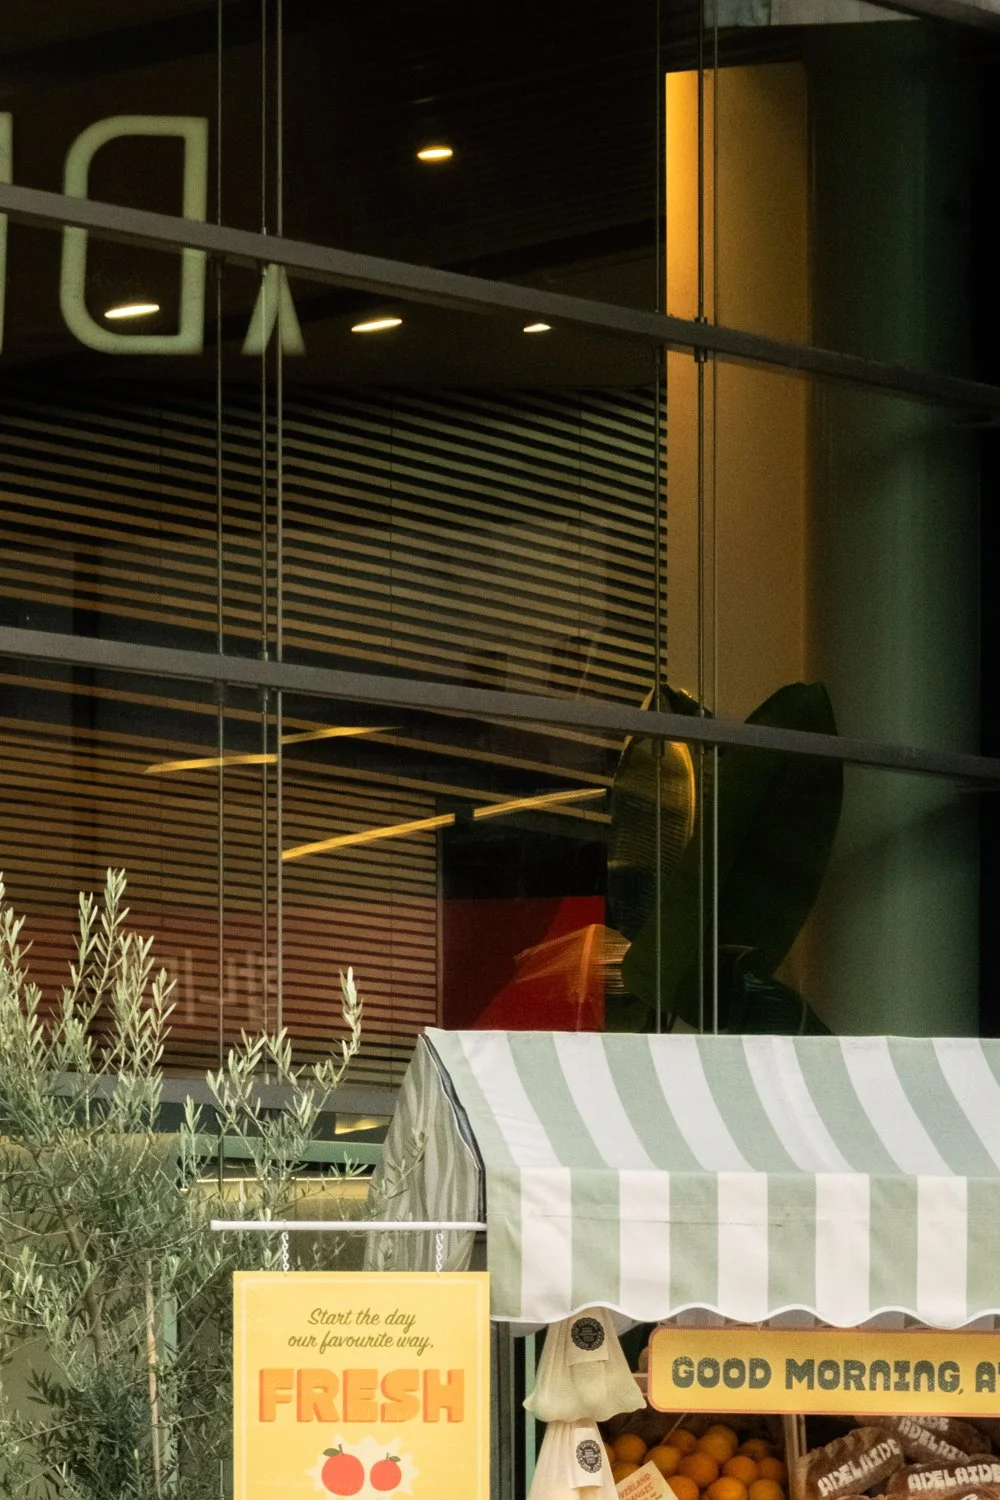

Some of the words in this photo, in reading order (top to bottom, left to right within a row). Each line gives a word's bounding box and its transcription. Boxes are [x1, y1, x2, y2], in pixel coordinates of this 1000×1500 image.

[307, 1308, 352, 1326] Start
[355, 1308, 380, 1326] the
[384, 1309, 416, 1334] day
[288, 1334, 317, 1348] our
[318, 1331, 394, 1356] favourite
[396, 1335, 435, 1356] way.
[671, 1356, 772, 1389] GOOD
[785, 1358, 965, 1395] MORNING,
[258, 1368, 465, 1423] FRESH
[817, 1438, 901, 1497] ADELAIDE
